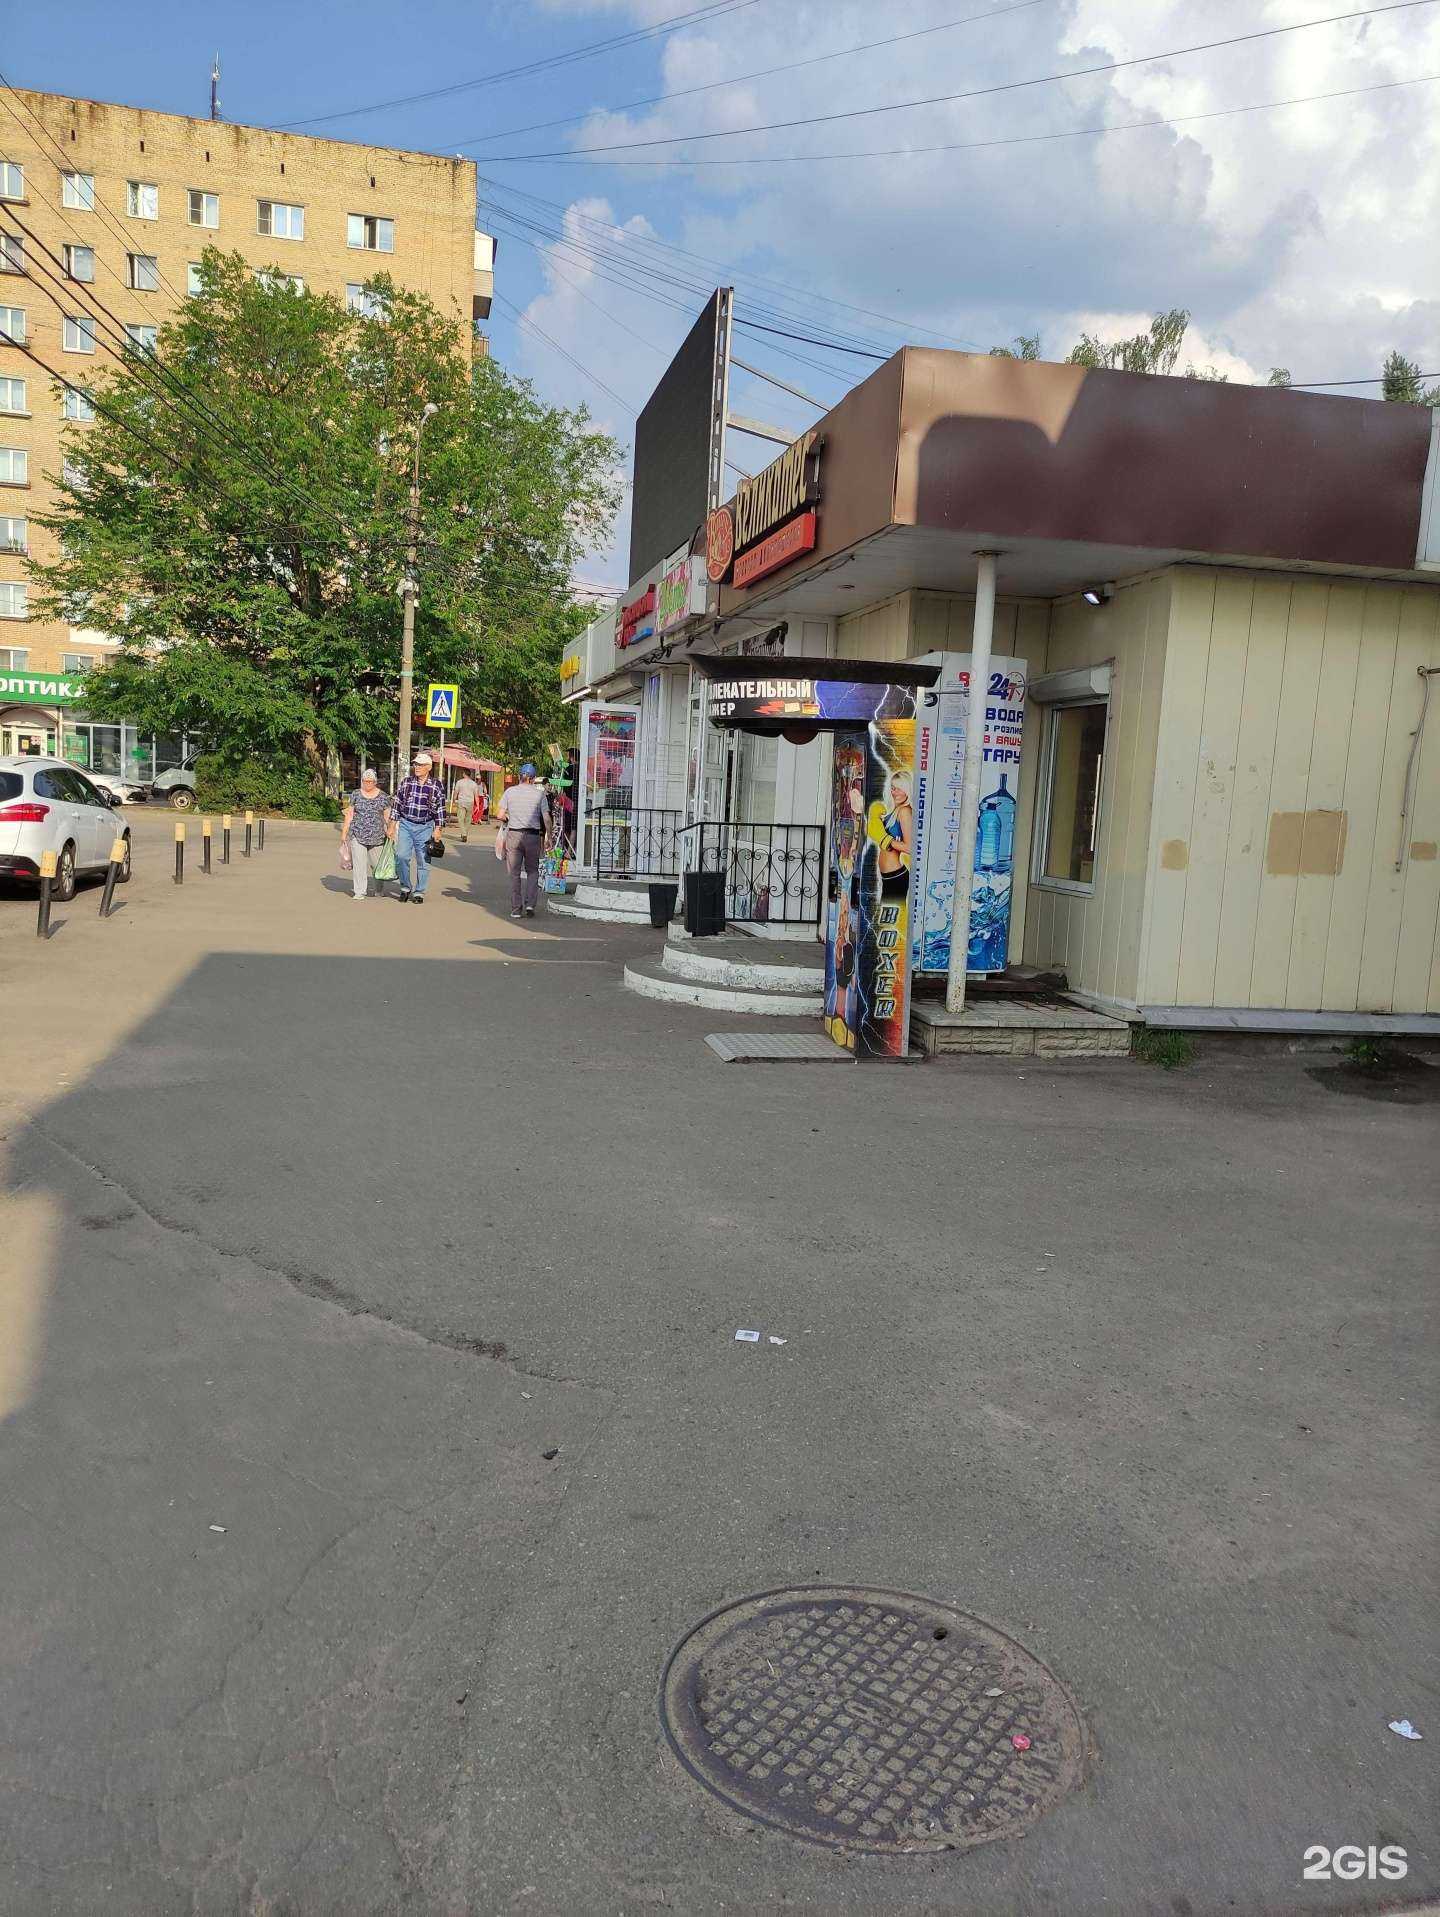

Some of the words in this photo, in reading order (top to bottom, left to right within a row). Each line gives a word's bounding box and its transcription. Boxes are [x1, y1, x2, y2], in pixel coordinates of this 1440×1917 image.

[710, 702, 736, 716] ЖЕР
[986, 707, 1024, 723] ВОДА
[984, 735, 991, 744] В
[983, 748, 1020, 764] ТАРУ
